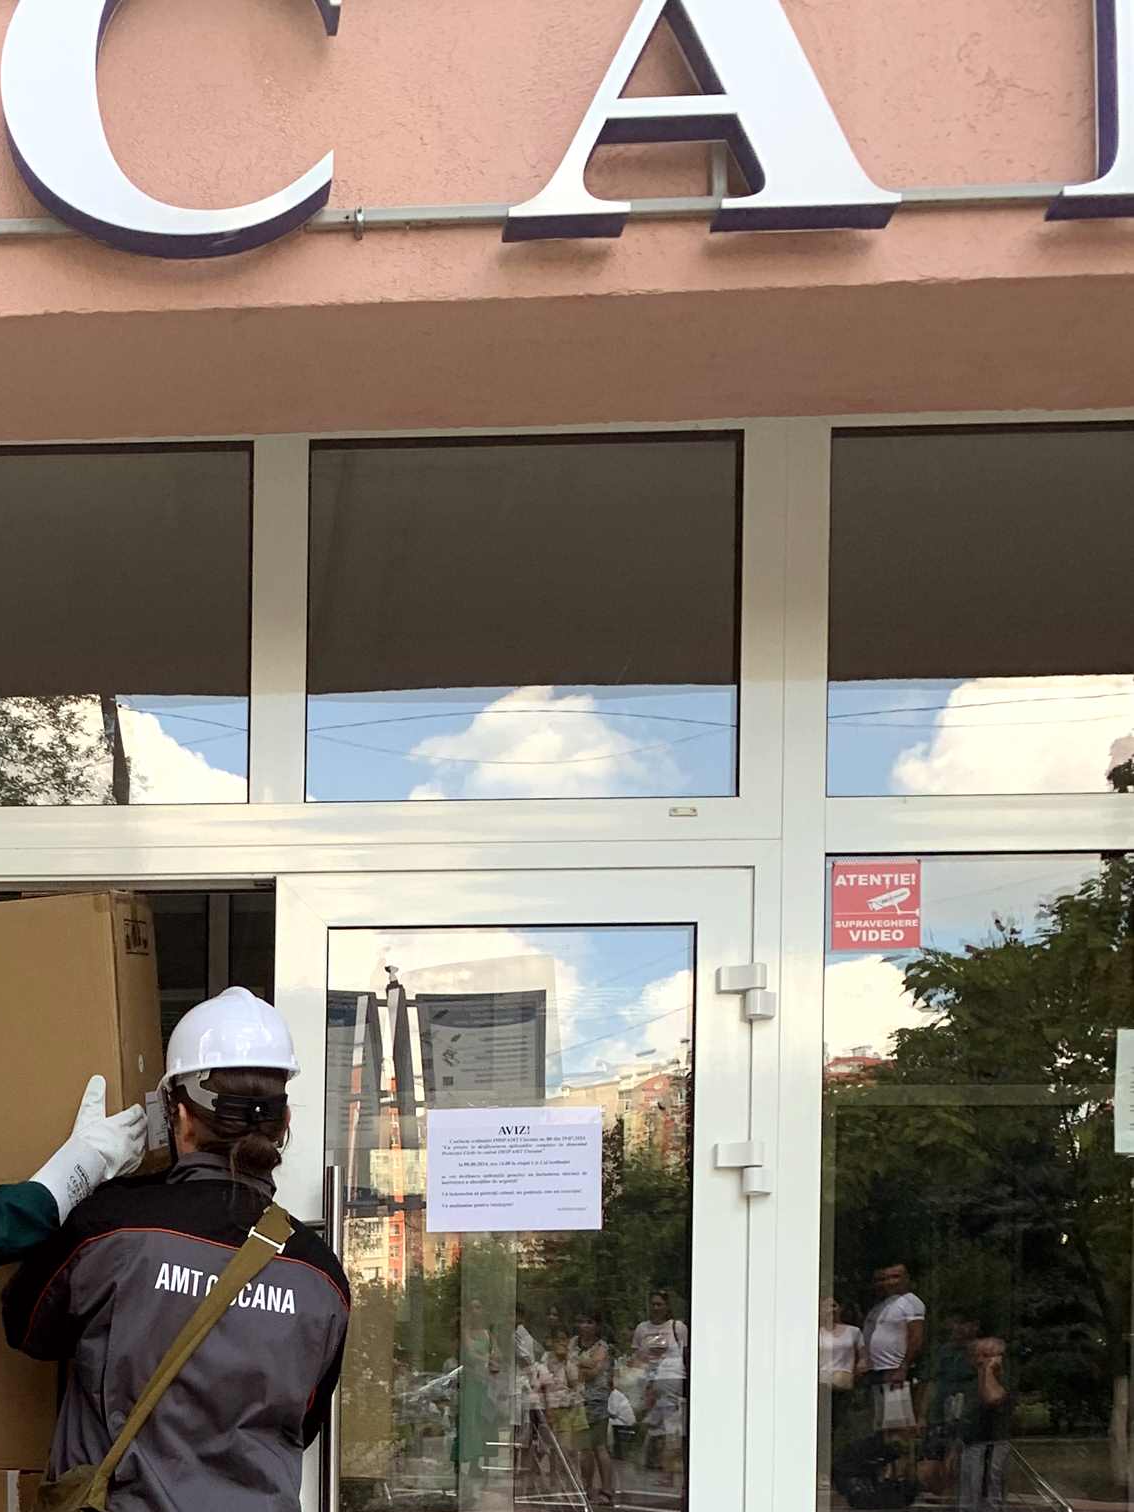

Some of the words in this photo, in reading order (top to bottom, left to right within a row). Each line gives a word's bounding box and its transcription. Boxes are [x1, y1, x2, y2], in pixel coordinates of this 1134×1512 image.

[834, 918, 919, 929] SUPRAVEGHERE
[849, 929, 904, 942] VIDEO
[498, 1125, 530, 1135] AVIZ!
[154, 1263, 204, 1297] AMT
[205, 1274, 296, 1314] CCANA
